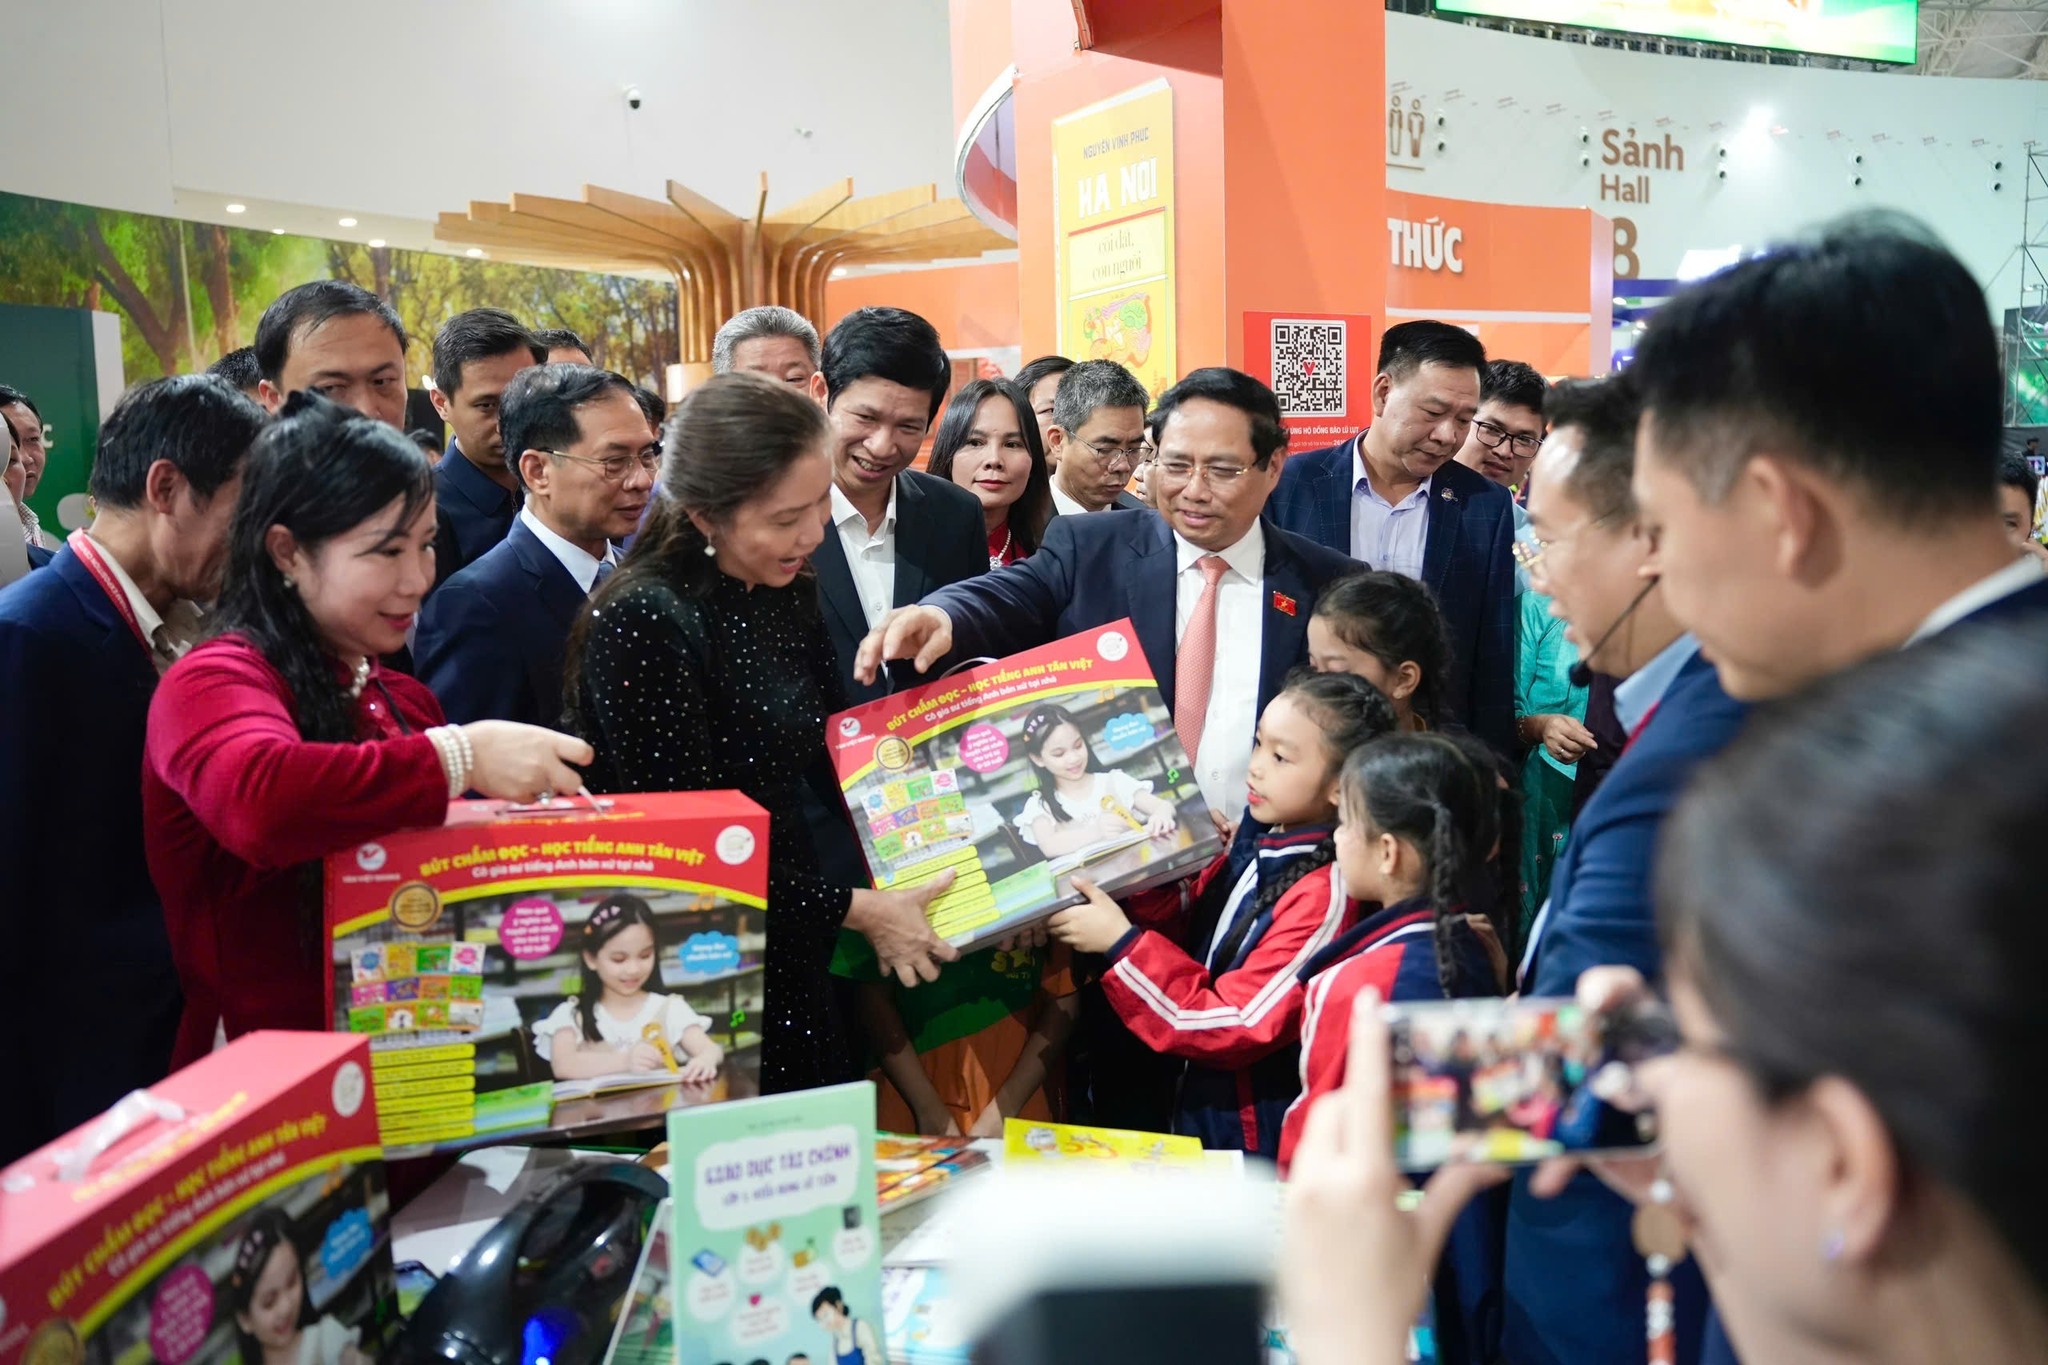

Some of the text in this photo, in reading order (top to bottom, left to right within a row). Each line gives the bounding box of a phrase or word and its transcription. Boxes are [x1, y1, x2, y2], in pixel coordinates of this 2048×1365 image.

[1602, 128, 1684, 171] Sảnh
[1600, 173, 1650, 204] Hall
[1387, 216, 1463, 274] THỨC
[886, 714, 907, 731] BÚT
[907, 699, 938, 719] CHẤM
[938, 689, 960, 706] ĐỌC
[968, 680, 990, 692] HỌC
[990, 668, 1021, 685] TIẾNG
[1023, 665, 1045, 679] ANH
[1047, 660, 1068, 673] TÂN
[1069, 657, 1093, 671] VIỆT
[541, 842, 571, 857] HỌC
[573, 834, 614, 854] TIẾNG
[615, 842, 646, 856] ANH
